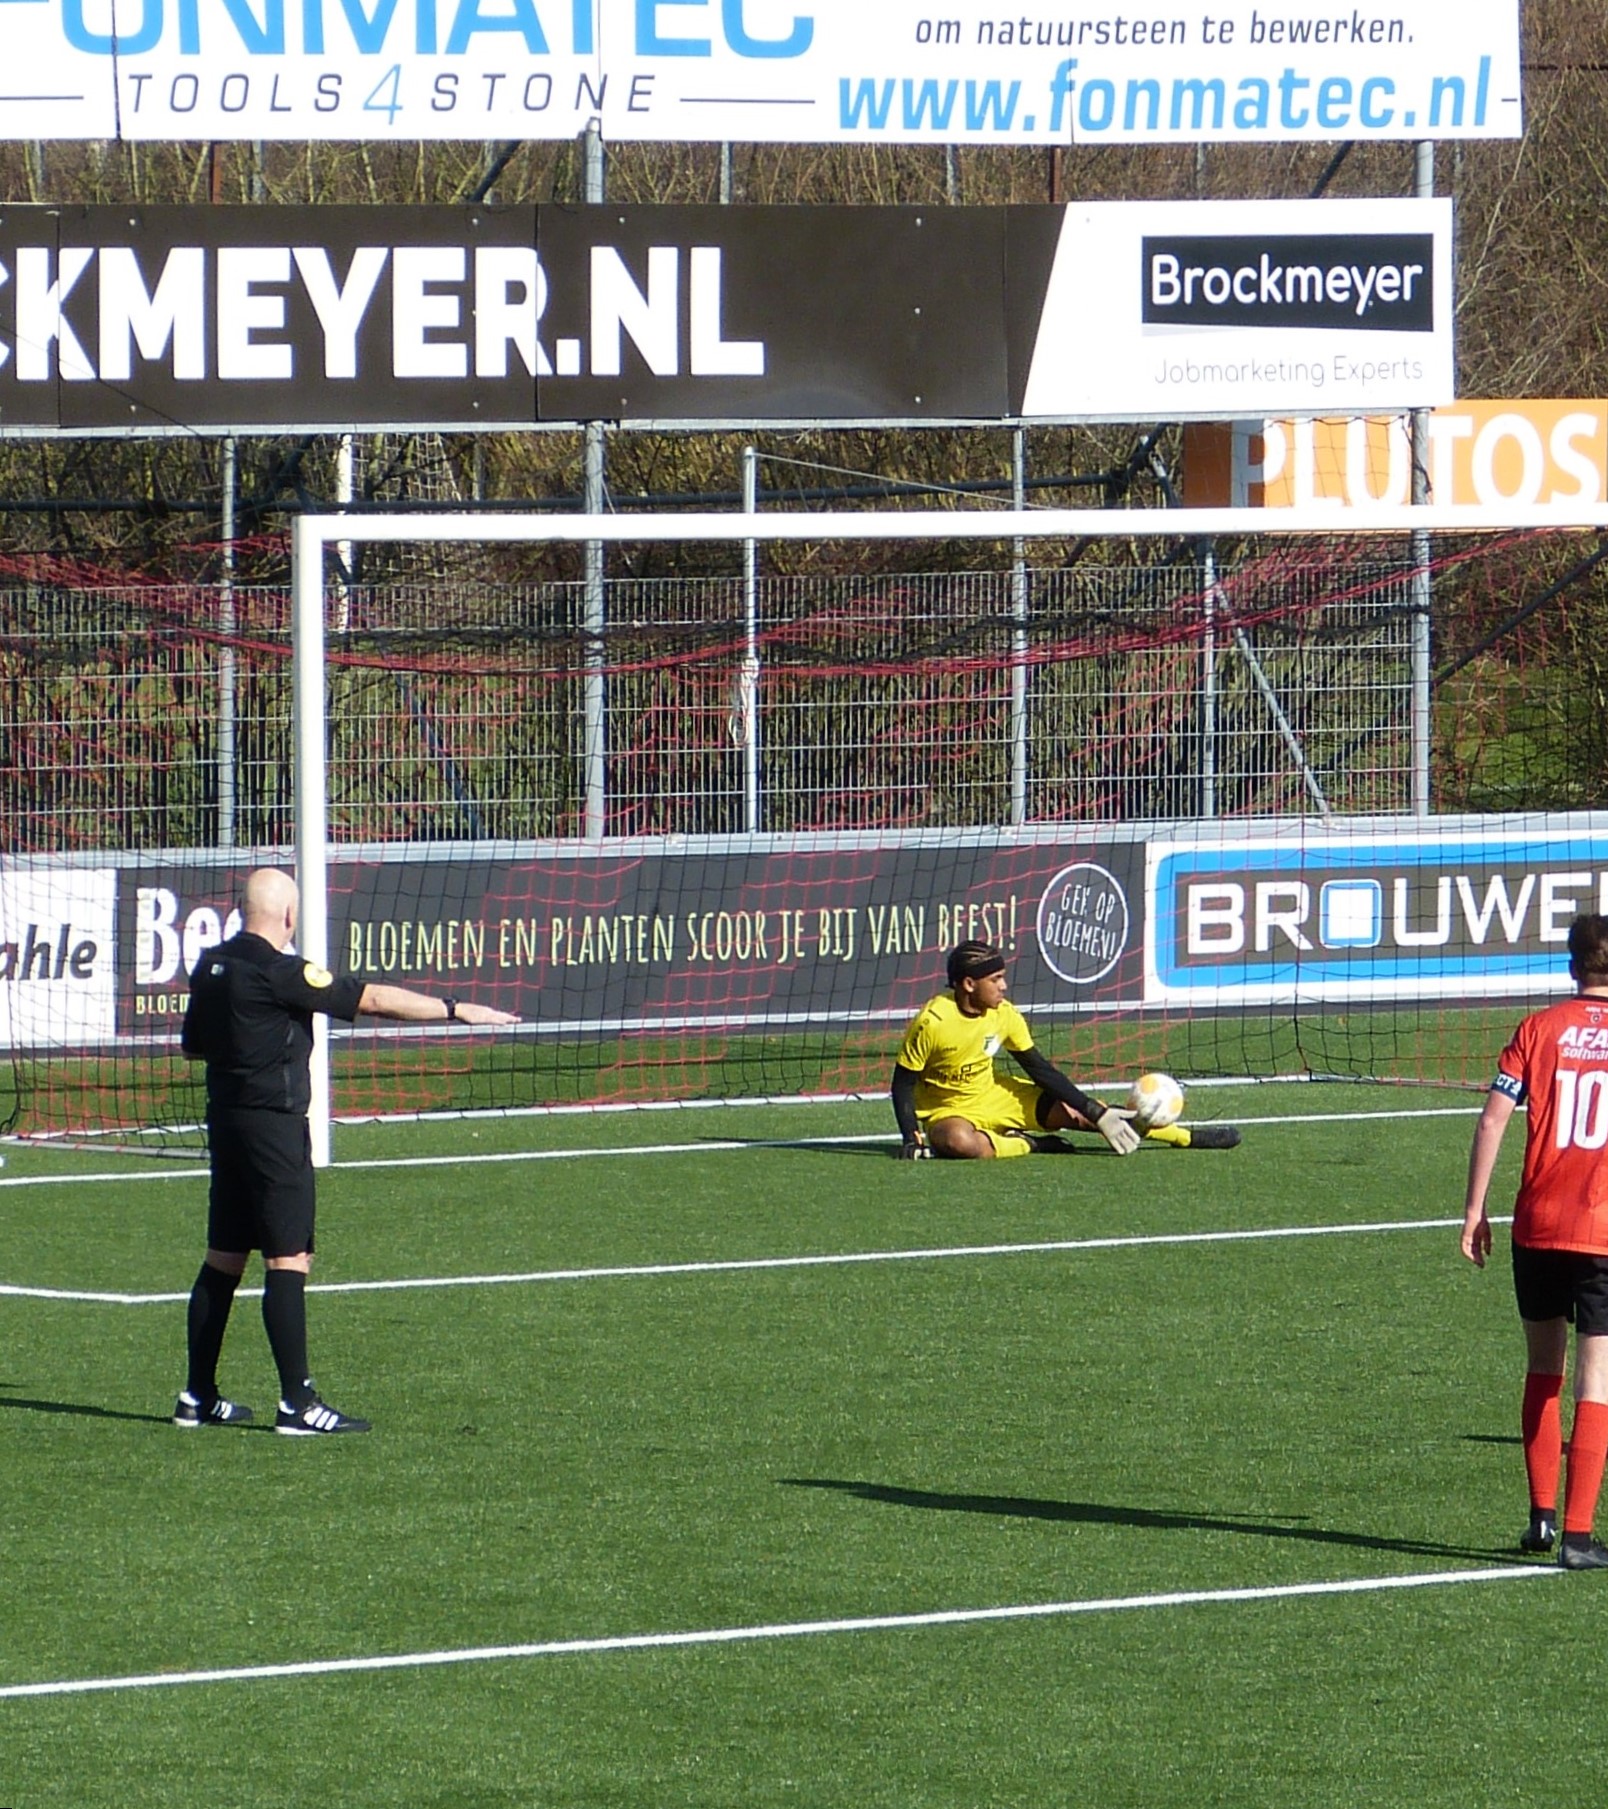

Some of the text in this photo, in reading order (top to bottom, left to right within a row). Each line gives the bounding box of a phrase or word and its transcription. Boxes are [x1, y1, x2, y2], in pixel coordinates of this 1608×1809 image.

[915, 9, 1416, 46] om natuursteen te bewerken.
[838, 55, 1492, 133] www.fonmatec.nl
[0, 247, 765, 381] KMEYER.NL
[1150, 253, 1424, 315] Brockmeyer
[1154, 354, 1424, 387] Jobmarketing Experts
[349, 920, 485, 973] BLOEMEN
[499, 918, 537, 968] EN
[551, 913, 675, 967] PLANTEN
[687, 910, 768, 962] SCOOR
[777, 909, 806, 964] JE
[819, 907, 858, 962] BIJ
[868, 904, 925, 955] VAN
[1095, 892, 1116, 924] OP
